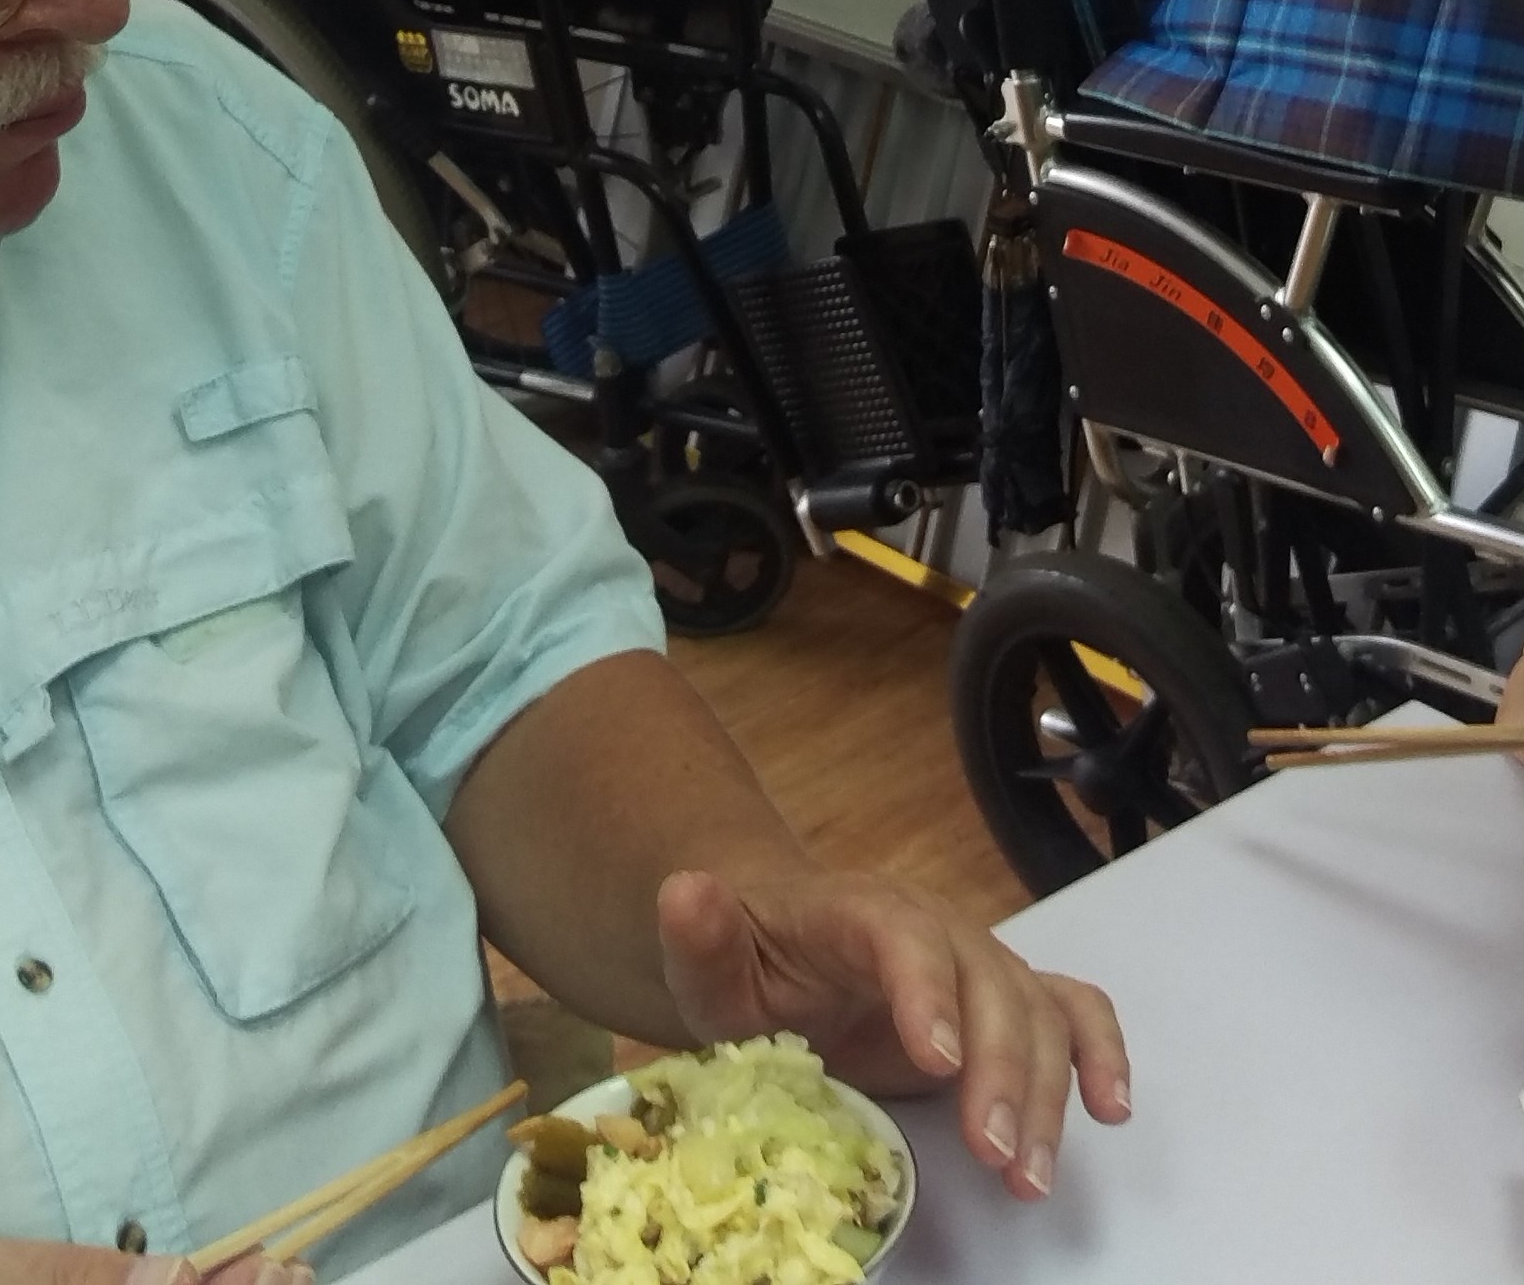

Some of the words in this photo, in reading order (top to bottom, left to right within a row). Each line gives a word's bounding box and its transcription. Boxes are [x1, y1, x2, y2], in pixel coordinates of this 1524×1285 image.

[447, 82, 521, 118] SOMA
[1098, 247, 1130, 272] Jia
[1150, 274, 1182, 301] Jin
